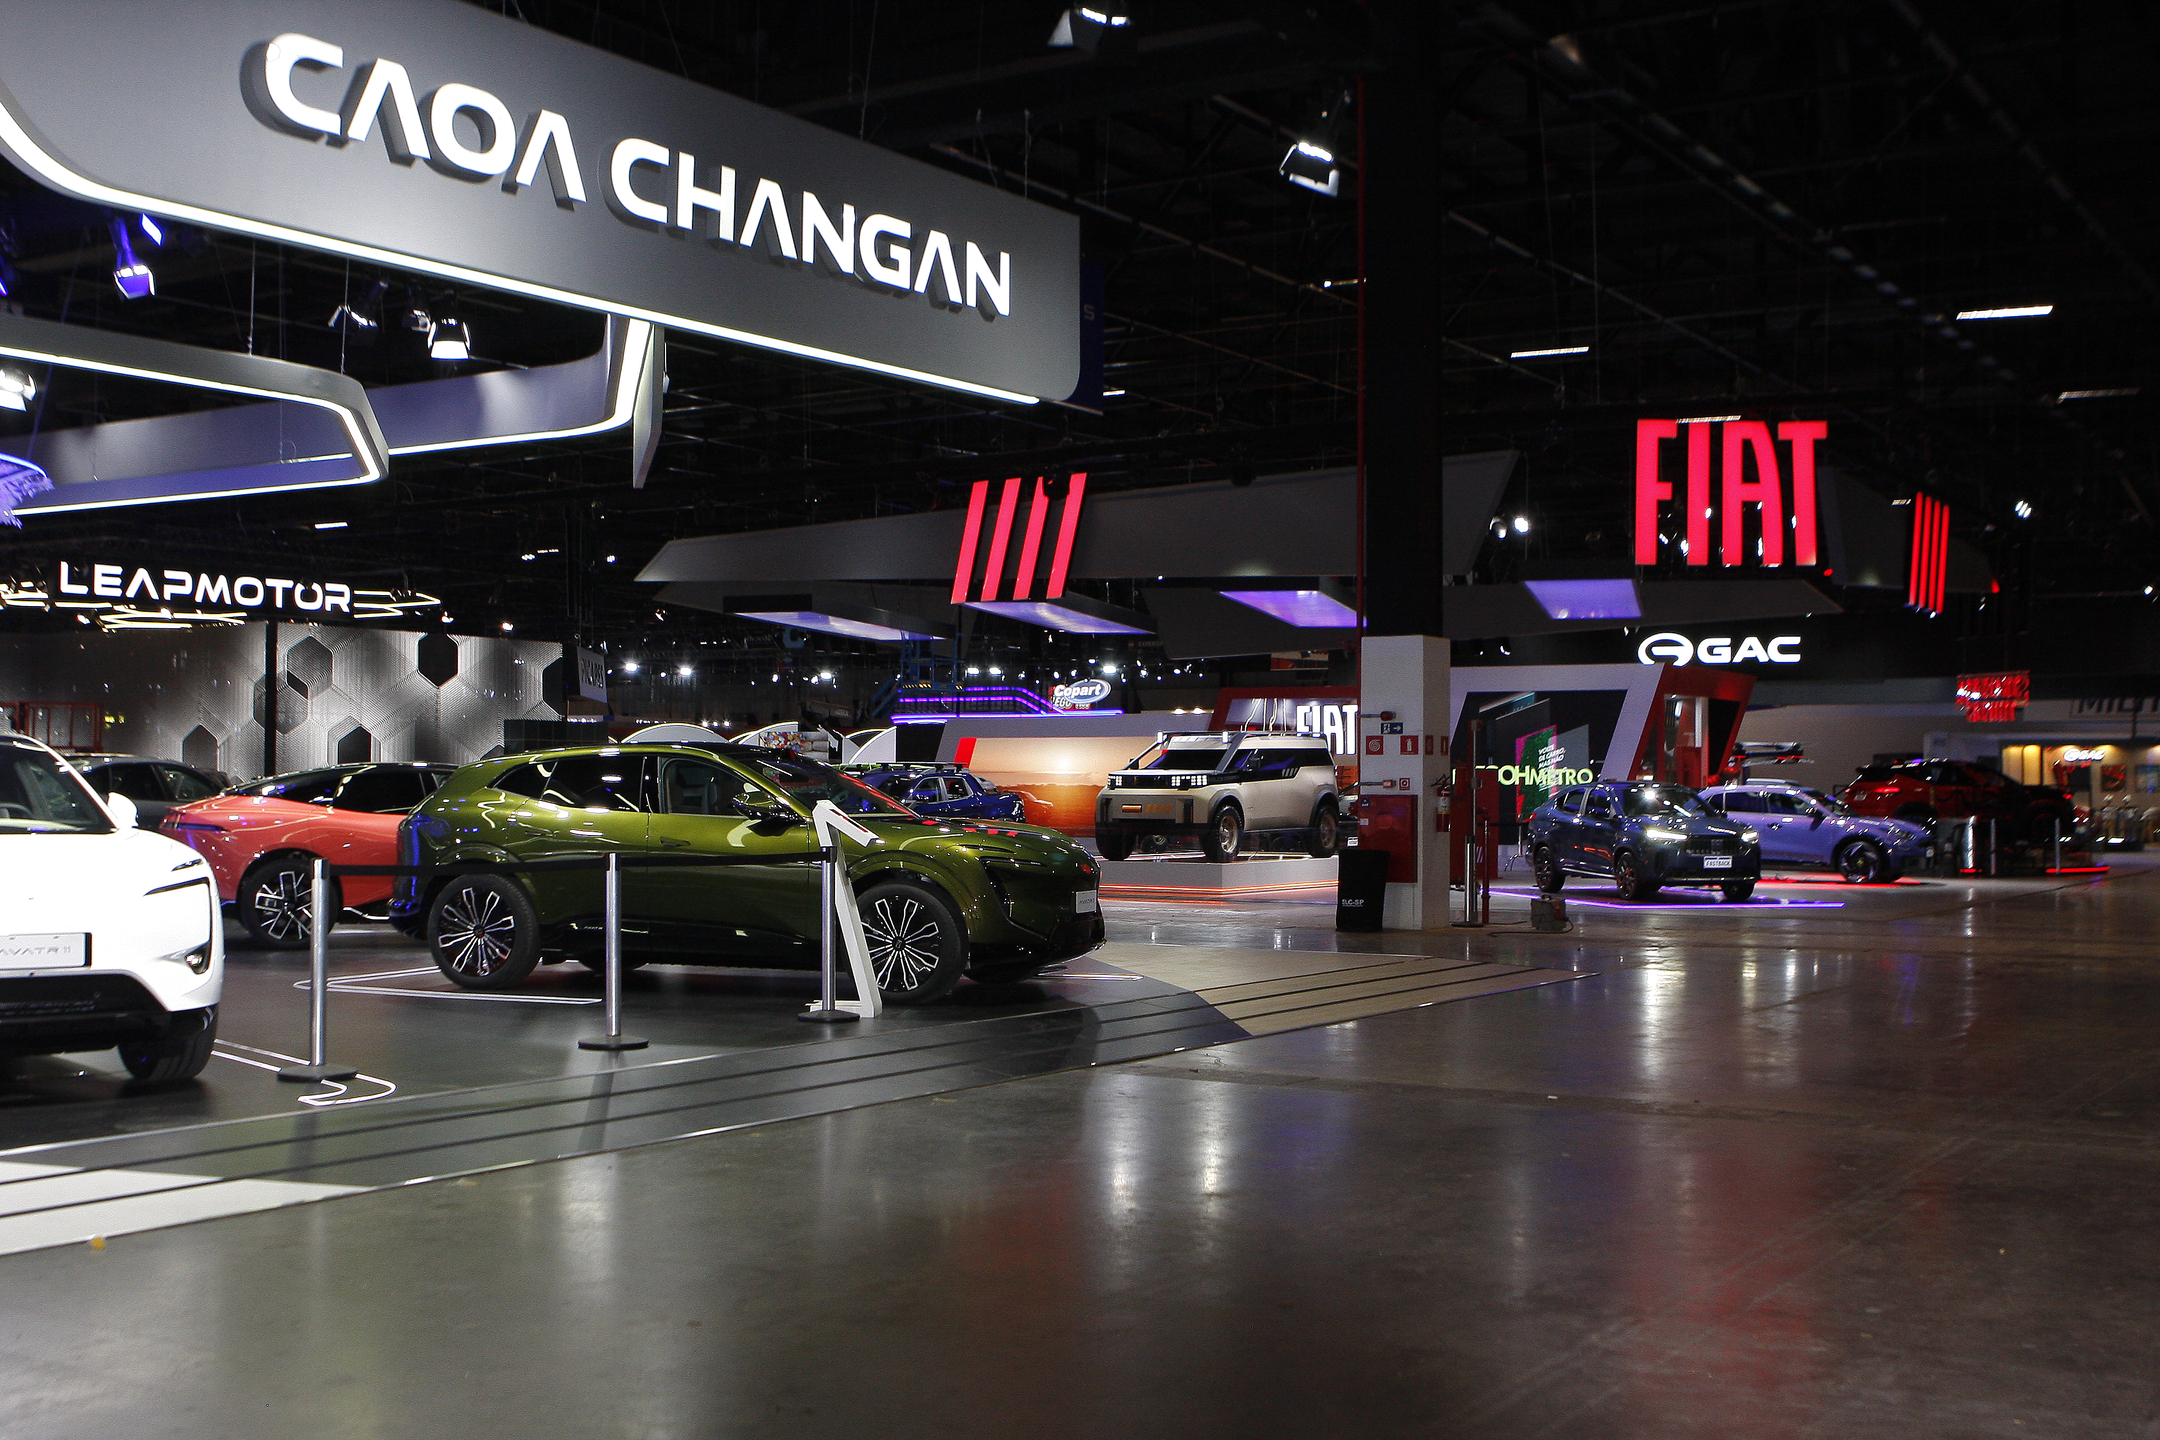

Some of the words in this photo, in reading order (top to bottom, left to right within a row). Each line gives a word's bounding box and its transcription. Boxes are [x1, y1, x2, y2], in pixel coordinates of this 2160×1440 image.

[265, 32, 587, 203] CAOA
[610, 137, 1011, 317] CHANGAN
[1635, 418, 1829, 567] FIAT
[58, 561, 353, 613] LEAPMOTOR
[1696, 636, 1802, 663] GAC
[1054, 683, 1102, 699] Copart
[1296, 704, 1359, 755] FIAT
[0, 946, 60, 956] AVATR
